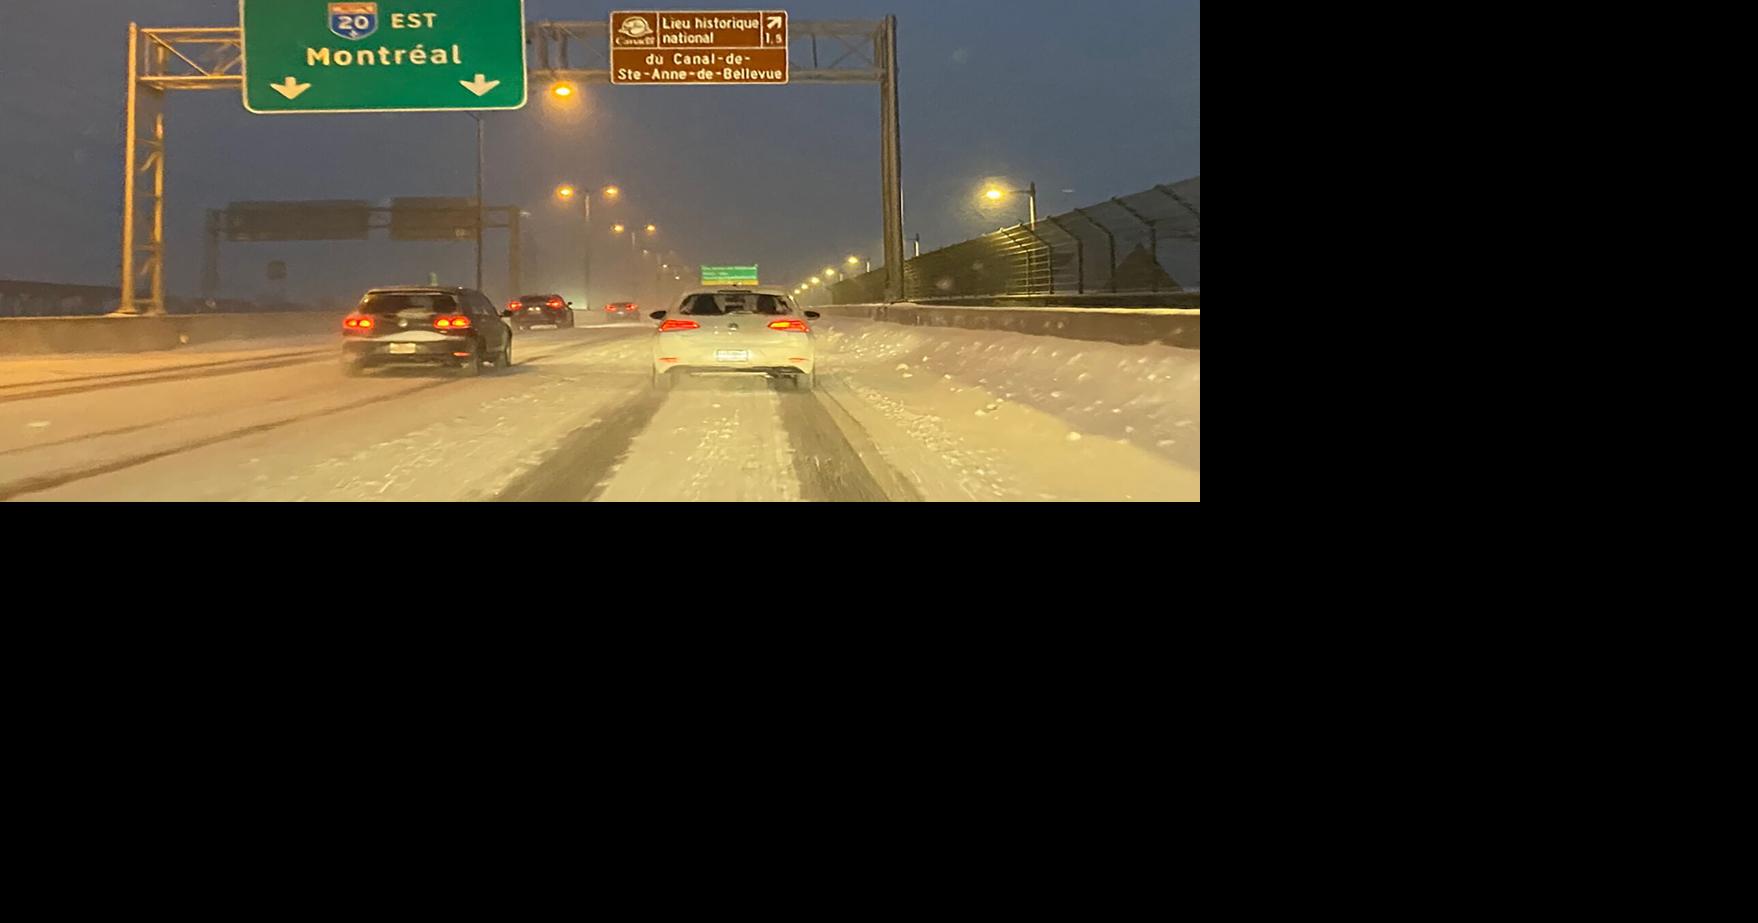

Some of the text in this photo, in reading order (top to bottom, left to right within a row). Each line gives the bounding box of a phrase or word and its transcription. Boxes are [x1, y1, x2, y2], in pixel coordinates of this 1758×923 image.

[338, 13, 437, 29] 20 EST
[662, 17, 760, 31] Lieu historique
[662, 32, 714, 44] national
[306, 44, 463, 66] Montréal
[645, 53, 750, 65] du Canal-de-
[617, 68, 782, 80] Ste-Anne-de-Bellevue
